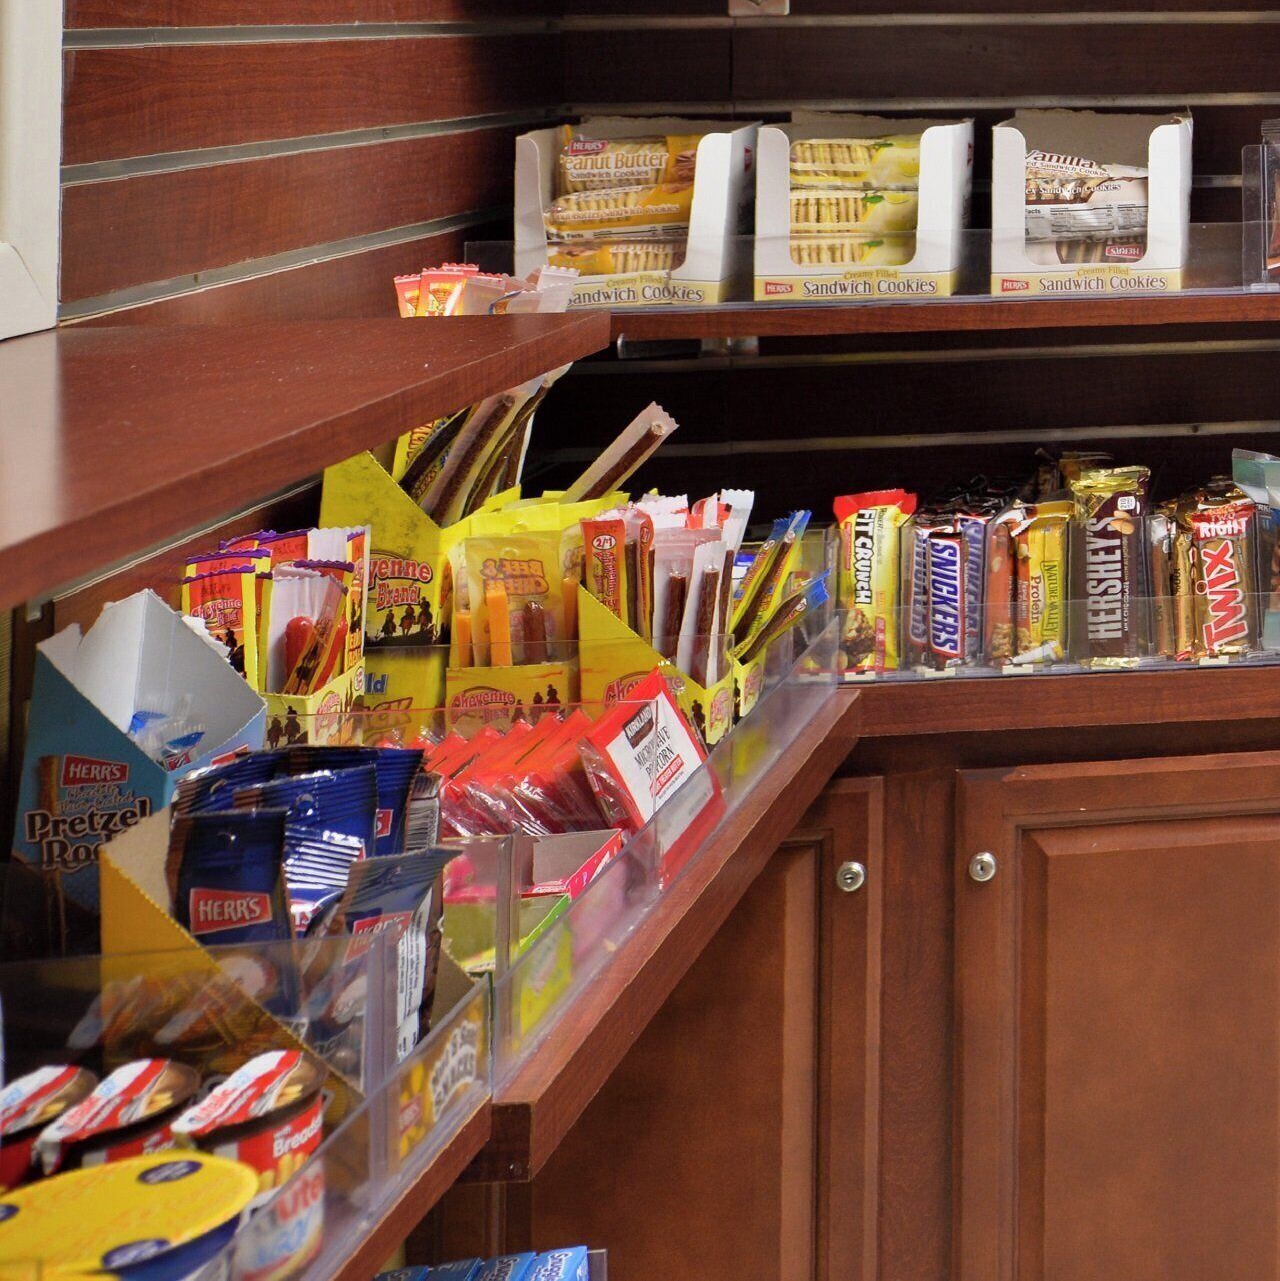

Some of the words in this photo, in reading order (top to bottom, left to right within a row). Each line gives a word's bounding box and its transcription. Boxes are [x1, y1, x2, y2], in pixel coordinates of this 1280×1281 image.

[843, 270, 872, 281] Creamy
[874, 270, 898, 279] Filled
[1038, 275, 1109, 293] Sandwich
[1110, 274, 1167, 291] Cookies
[802, 278, 873, 297] Sandwich
[877, 278, 936, 294] Cookies
[1086, 515, 1114, 640] HERSHEY'S
[375, 585, 420, 610] Brand
[929, 541, 960, 654] SNICKERS
[1030, 575, 1044, 626] Protein
[1203, 540, 1248, 650] TWIX
[190, 597, 242, 619] Cheyenne
[68, 763, 121, 779] HERR'S
[25, 799, 151, 842] Pretzel
[199, 898, 261, 920] HERR'S
